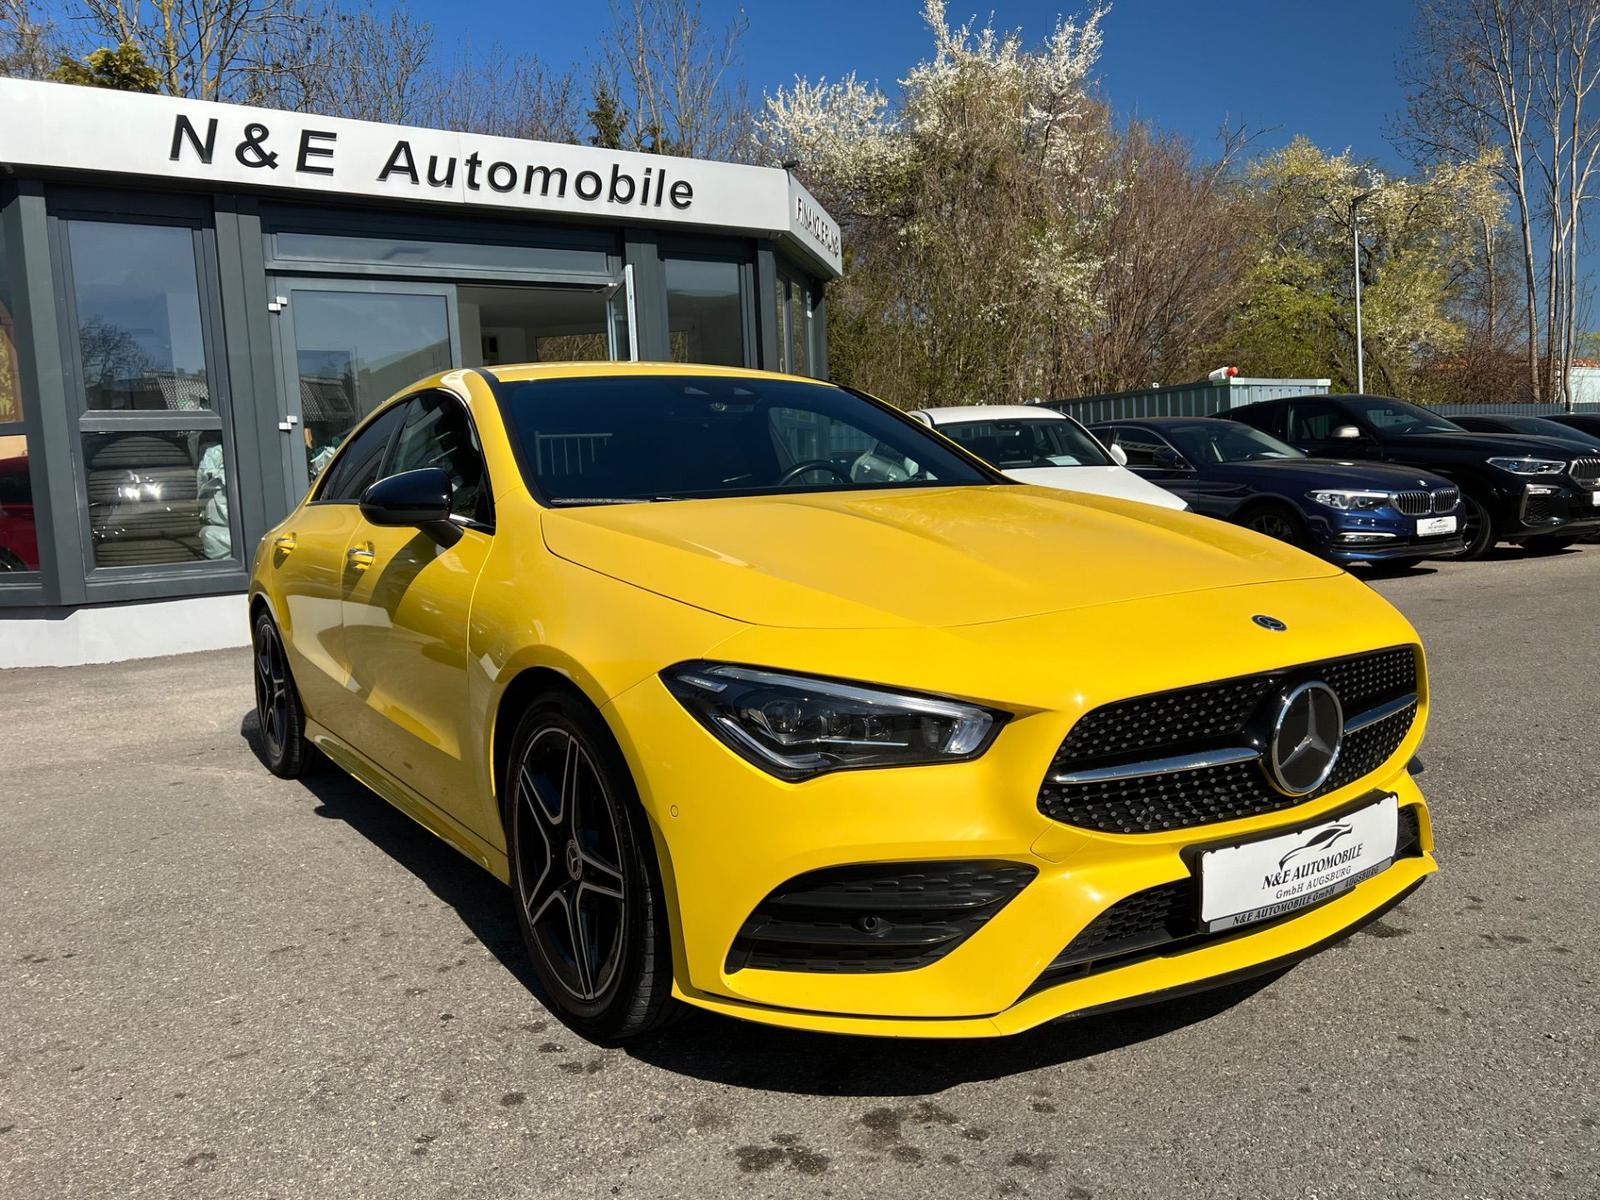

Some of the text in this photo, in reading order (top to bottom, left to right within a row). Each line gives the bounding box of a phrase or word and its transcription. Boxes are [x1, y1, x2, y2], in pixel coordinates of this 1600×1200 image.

[376, 140, 694, 210] Automobile
[1262, 843, 1364, 890] N&E AUTOMOBILE
[1276, 866, 1351, 899] GmbH AUGSBURG
[1232, 913, 1253, 926] N&E
[1254, 897, 1311, 920] AUTOMOBILE
[1312, 886, 1336, 901] GmbH
